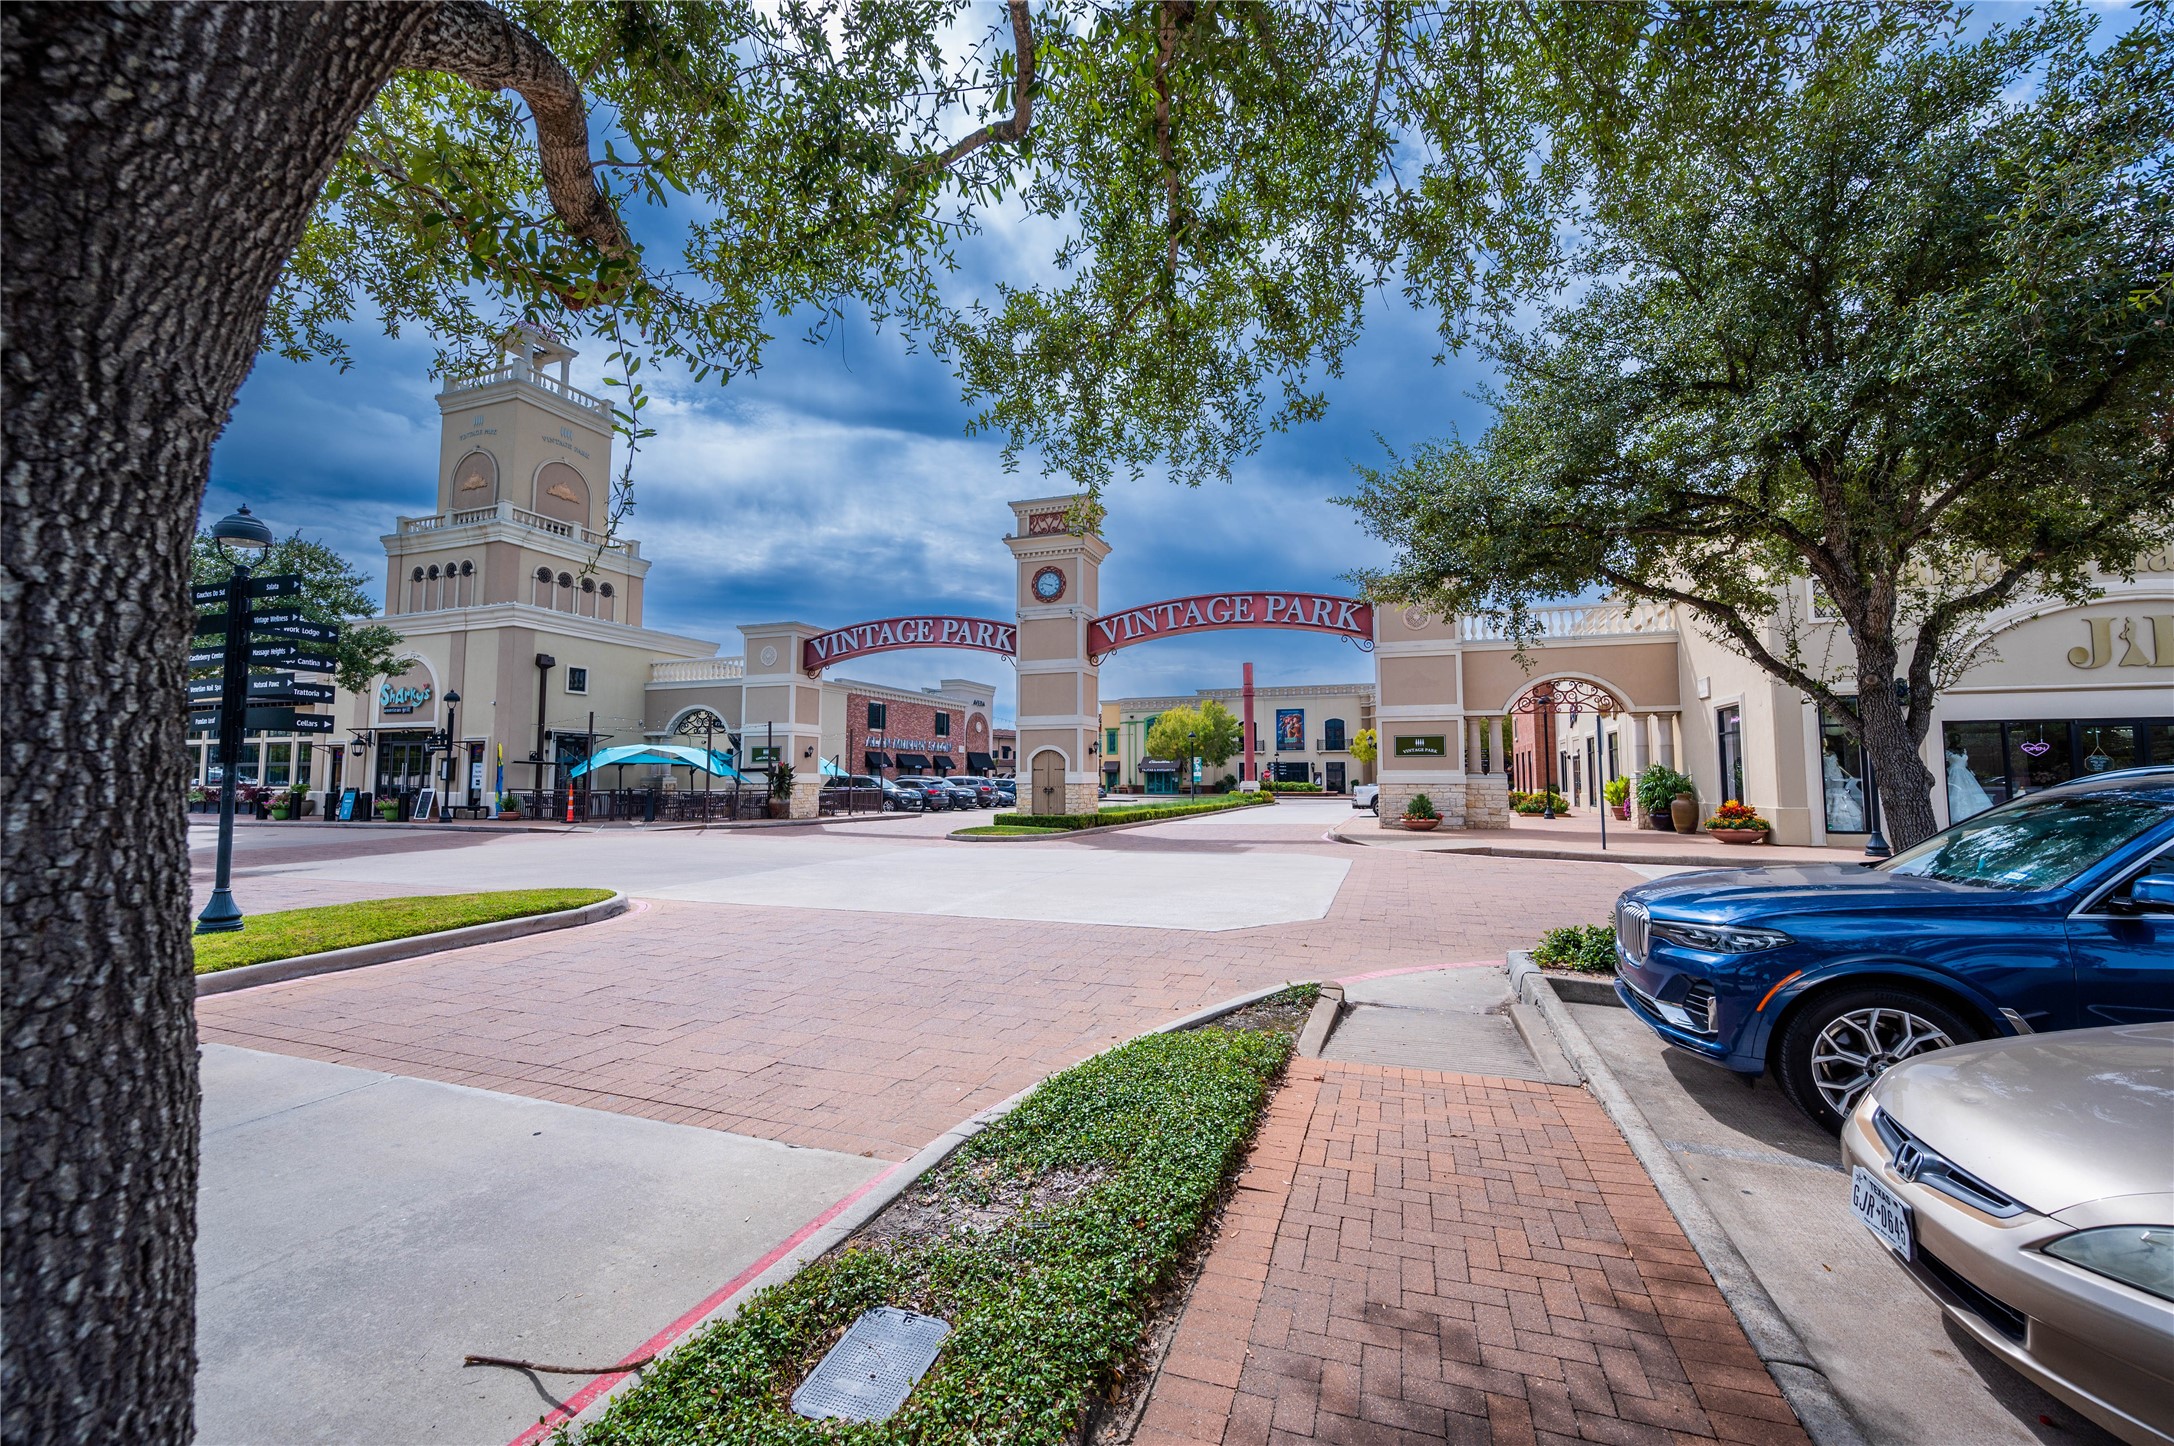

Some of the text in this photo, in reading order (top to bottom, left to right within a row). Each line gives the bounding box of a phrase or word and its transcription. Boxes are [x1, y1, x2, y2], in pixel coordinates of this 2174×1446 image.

[266, 583, 279, 591] Salata
[253, 615, 289, 624] Vintage Wellness
[1096, 595, 1363, 643] VINTAGE PARK
[301, 627, 321, 637] Lodge
[811, 619, 1016, 660] VINTAGE PARK
[211, 652, 225, 660] Center
[252, 647, 286, 657] Massage Heights
[297, 658, 321, 667] Cantina
[206, 684, 214, 692] Nail
[214, 684, 222, 692] Spa
[293, 688, 320, 697] Trattoria
[296, 719, 319, 727] Cellars
[1869, 1181, 1891, 1205] TEXAS
